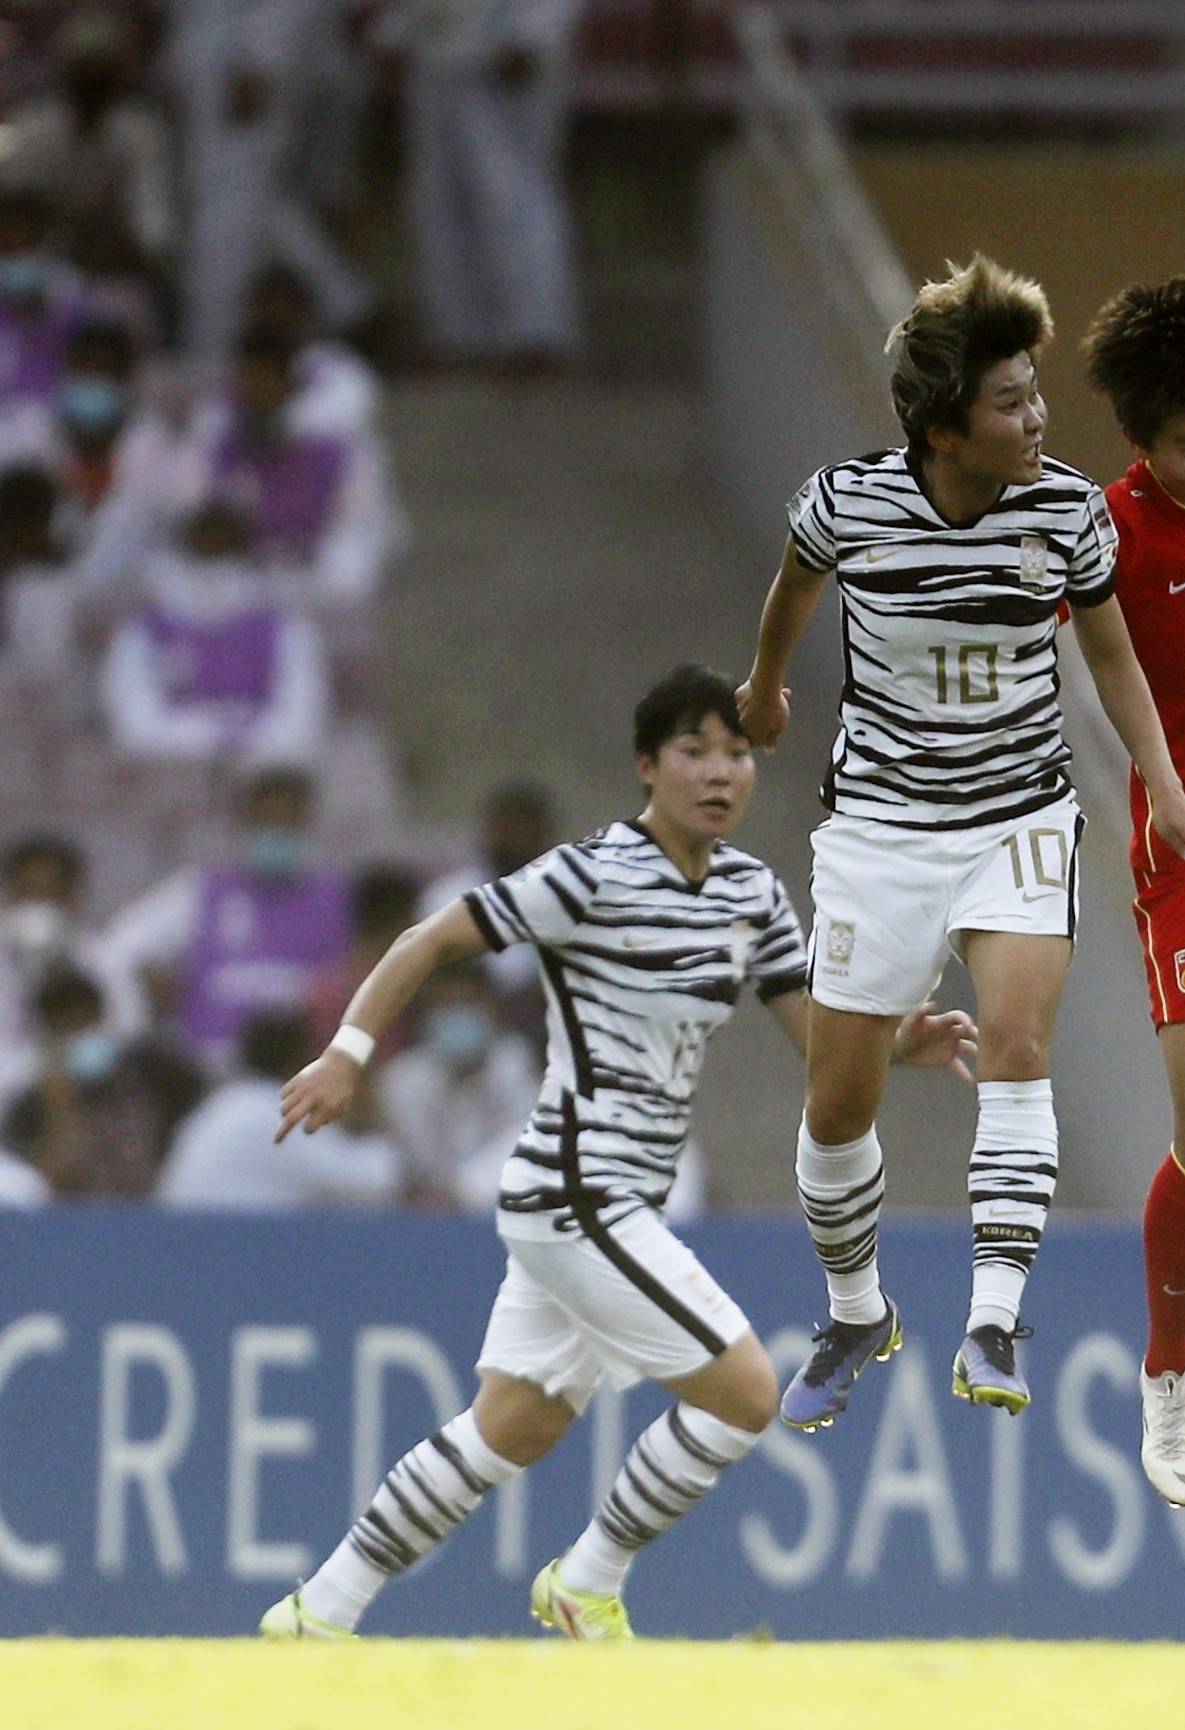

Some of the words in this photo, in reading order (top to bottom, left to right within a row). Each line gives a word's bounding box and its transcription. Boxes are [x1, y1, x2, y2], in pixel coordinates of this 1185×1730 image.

[928, 644, 999, 704] 10
[1002, 828, 1069, 890] 10
[982, 1226, 1034, 1241] KOREA
